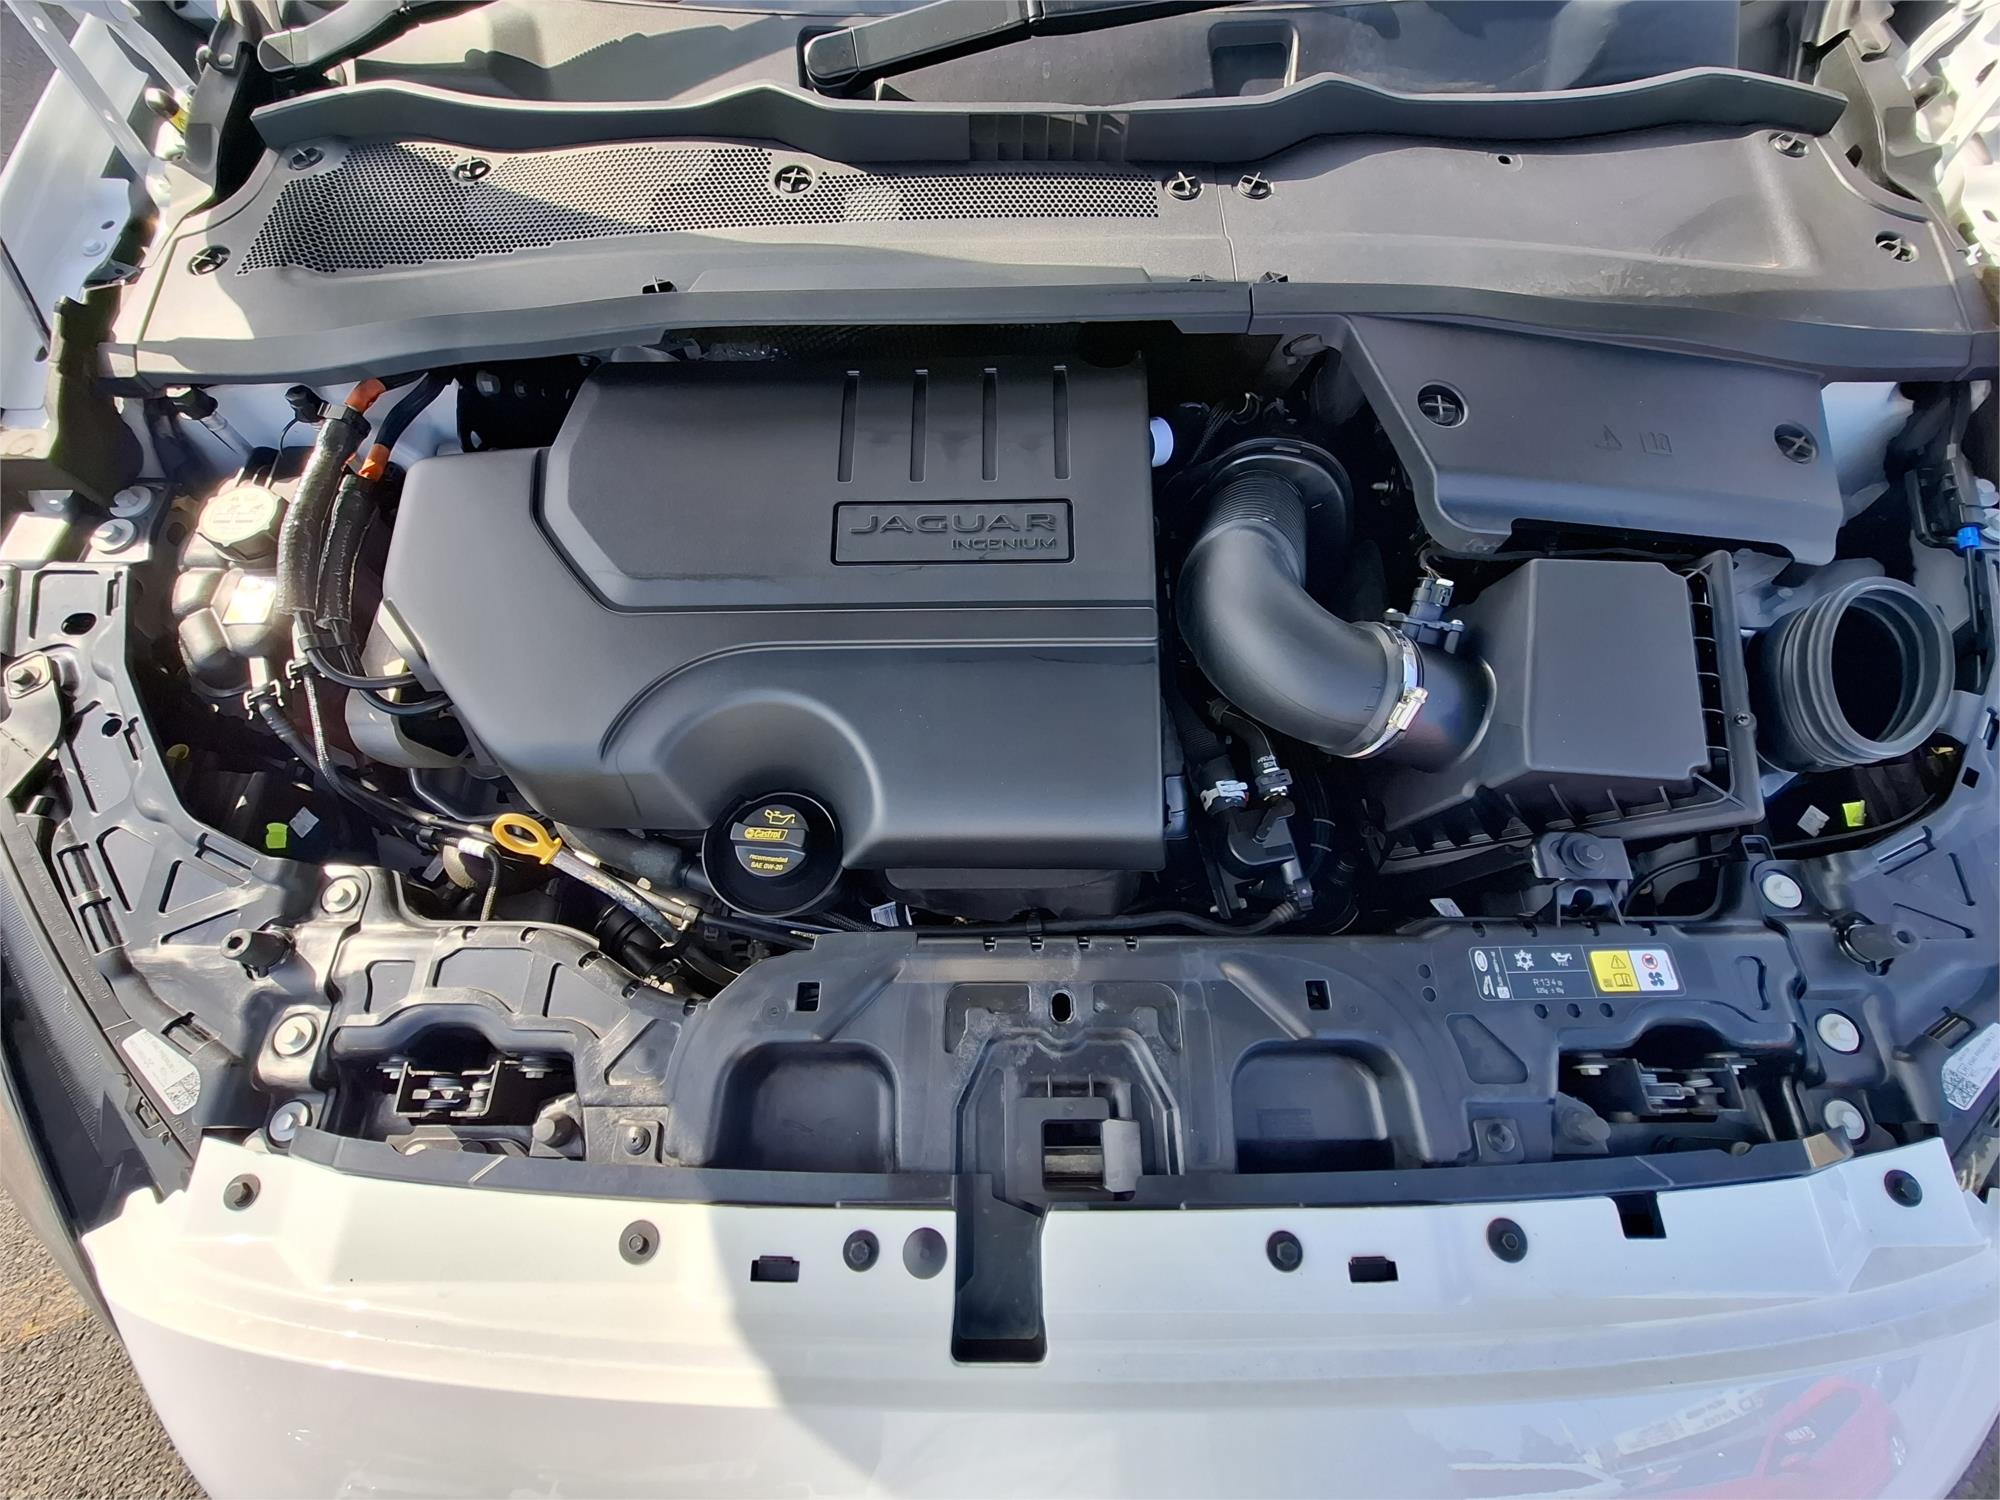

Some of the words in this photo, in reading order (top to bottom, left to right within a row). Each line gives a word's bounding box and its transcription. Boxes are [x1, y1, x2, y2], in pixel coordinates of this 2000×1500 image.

[849, 513, 1056, 533] JAGUAR
[950, 537, 1057, 550] INGENIUM
[754, 830, 782, 839] Castrol
[749, 854, 788, 863] recommended
